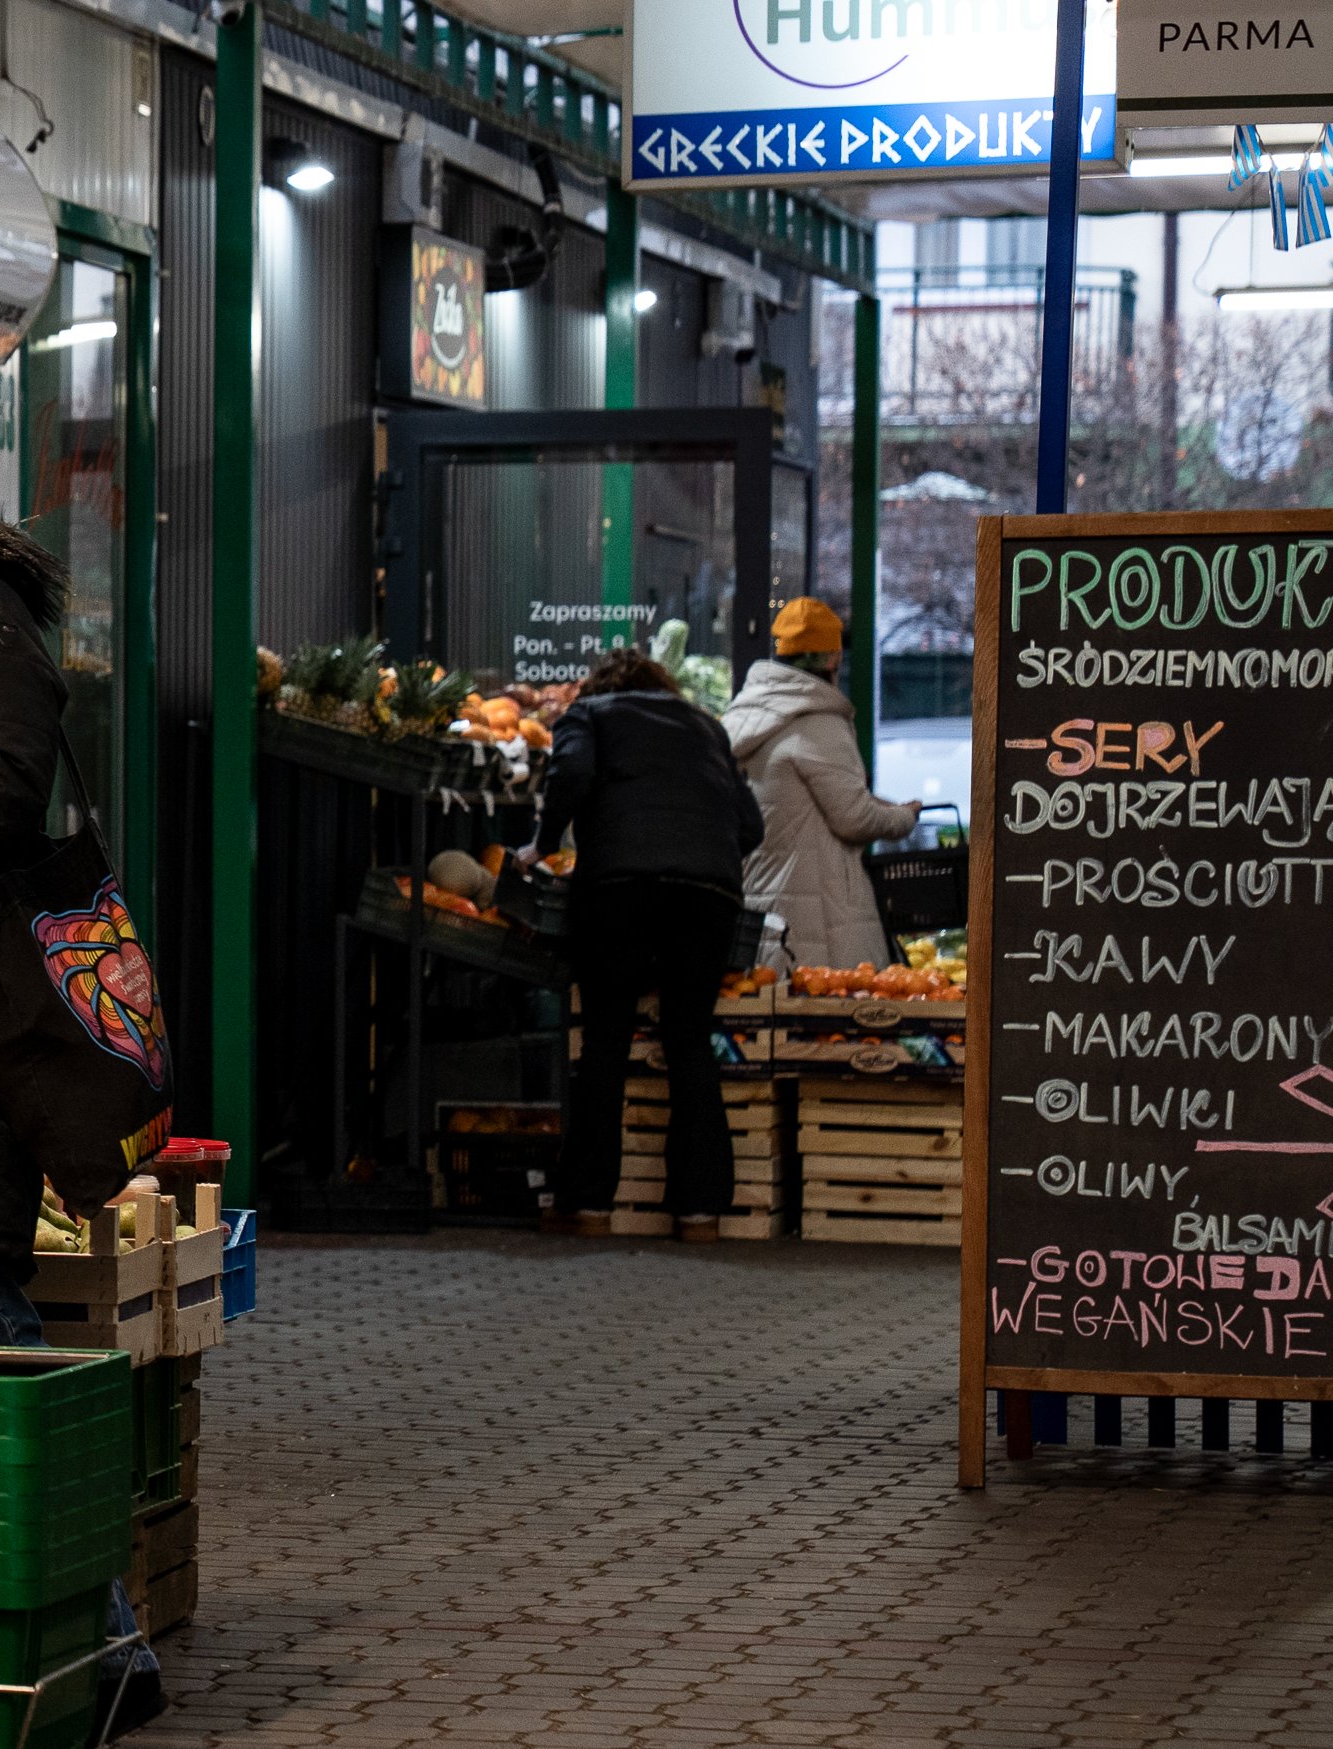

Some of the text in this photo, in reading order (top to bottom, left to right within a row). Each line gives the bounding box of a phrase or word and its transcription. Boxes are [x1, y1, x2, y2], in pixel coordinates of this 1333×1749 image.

[1159, 20, 1315, 53] PARMA
[638, 106, 1103, 174] GRECKIE PRODUKY
[529, 601, 657, 625] Zapraszamy
[514, 635, 558, 655] Pon.
[581, 634, 608, 655] Pt.
[991, 1281, 1327, 1359] WEGAŃSKIE
